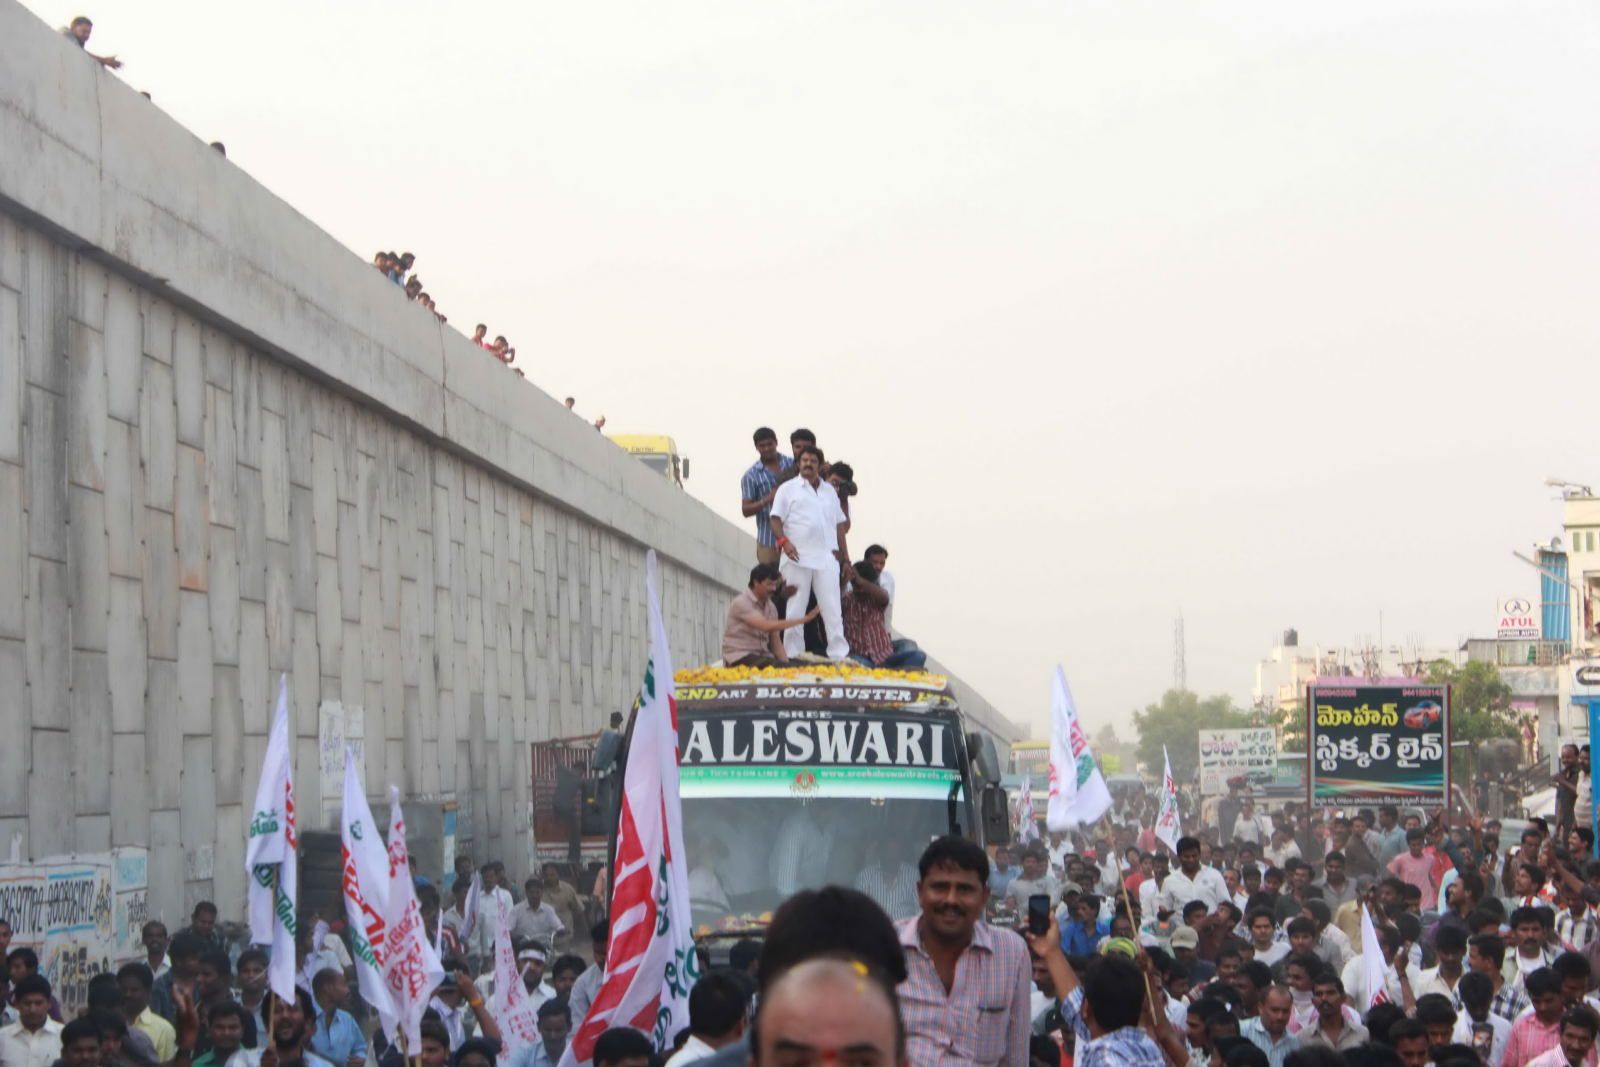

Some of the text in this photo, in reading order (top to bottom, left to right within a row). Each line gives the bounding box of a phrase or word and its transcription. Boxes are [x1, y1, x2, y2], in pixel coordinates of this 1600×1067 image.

[1501, 617, 1536, 626] ATUL
[756, 686, 823, 699] BLOCK
[830, 687, 911, 701] BUSTER
[1317, 703, 1399, 726] మోహన్
[681, 720, 945, 767] ALESWARI
[1316, 733, 1442, 771] స్టిక్కర్ లైన్
